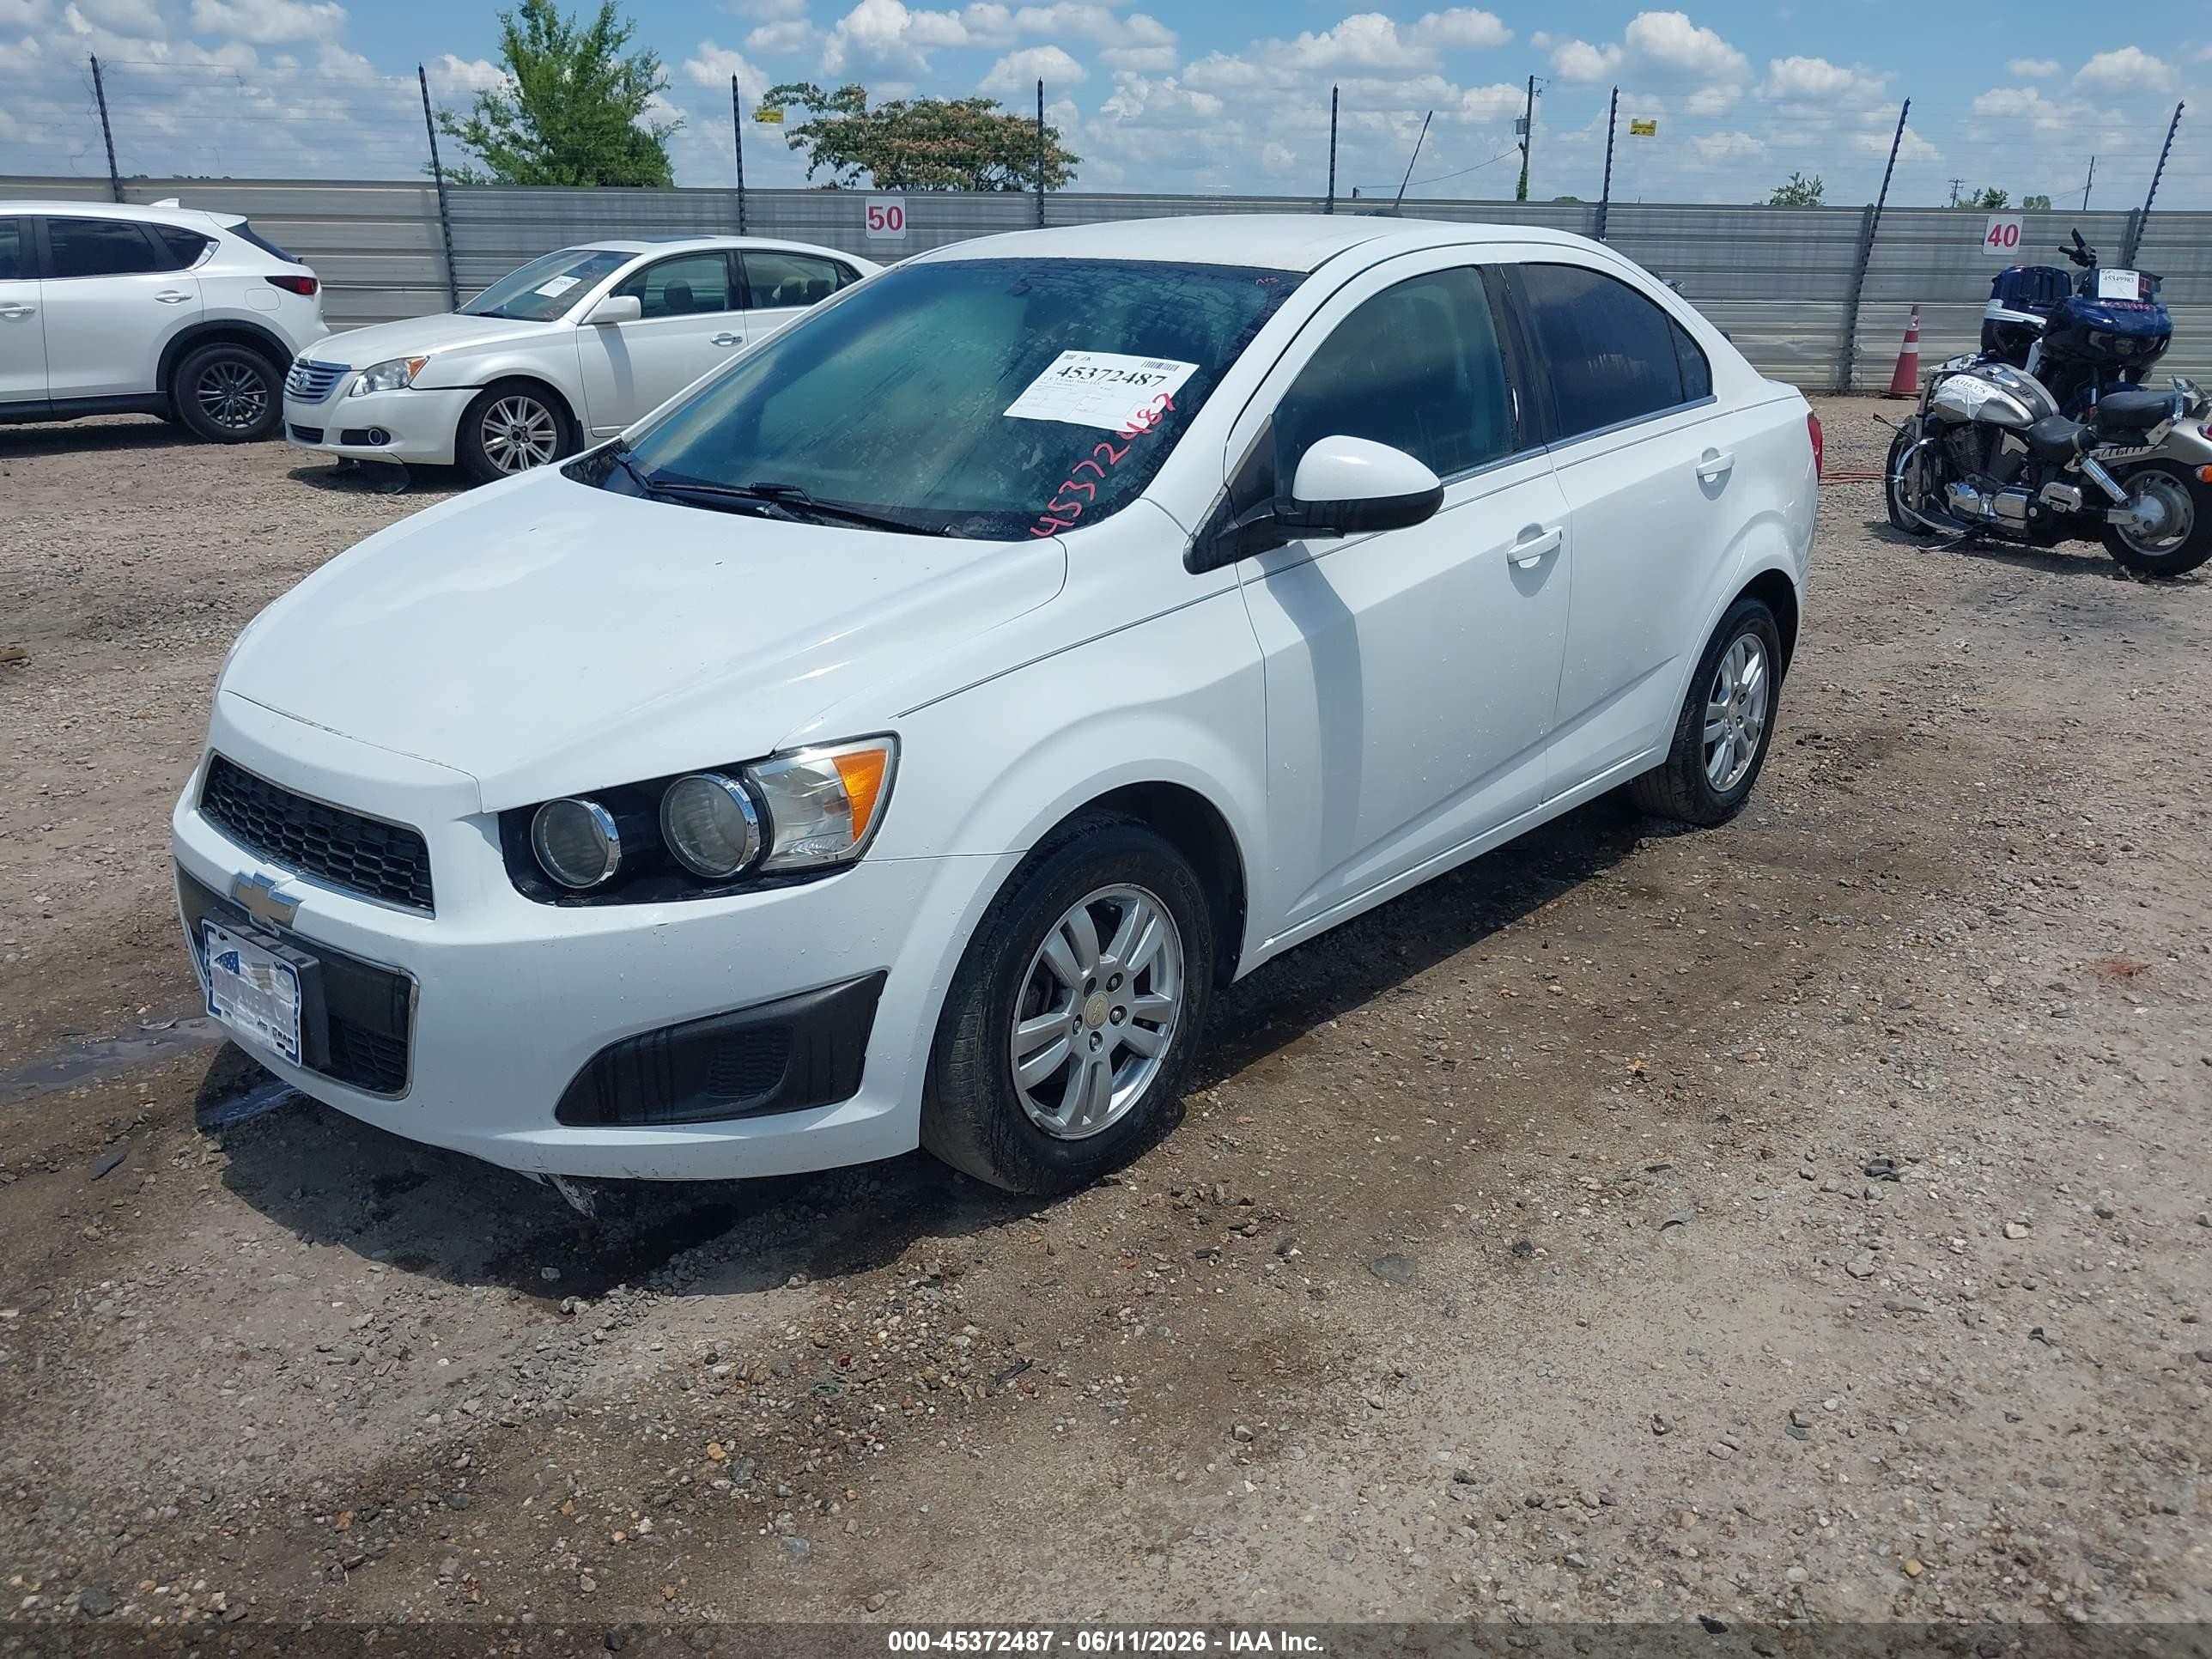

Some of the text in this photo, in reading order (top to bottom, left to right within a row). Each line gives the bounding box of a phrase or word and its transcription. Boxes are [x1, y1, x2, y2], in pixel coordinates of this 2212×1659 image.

[868, 206, 902, 231] 50
[1987, 224, 2019, 247] 40
[1056, 365, 1168, 387] 45372487
[1030, 392, 1176, 537] 45372487
[277, 1032, 294, 1046] RAM
